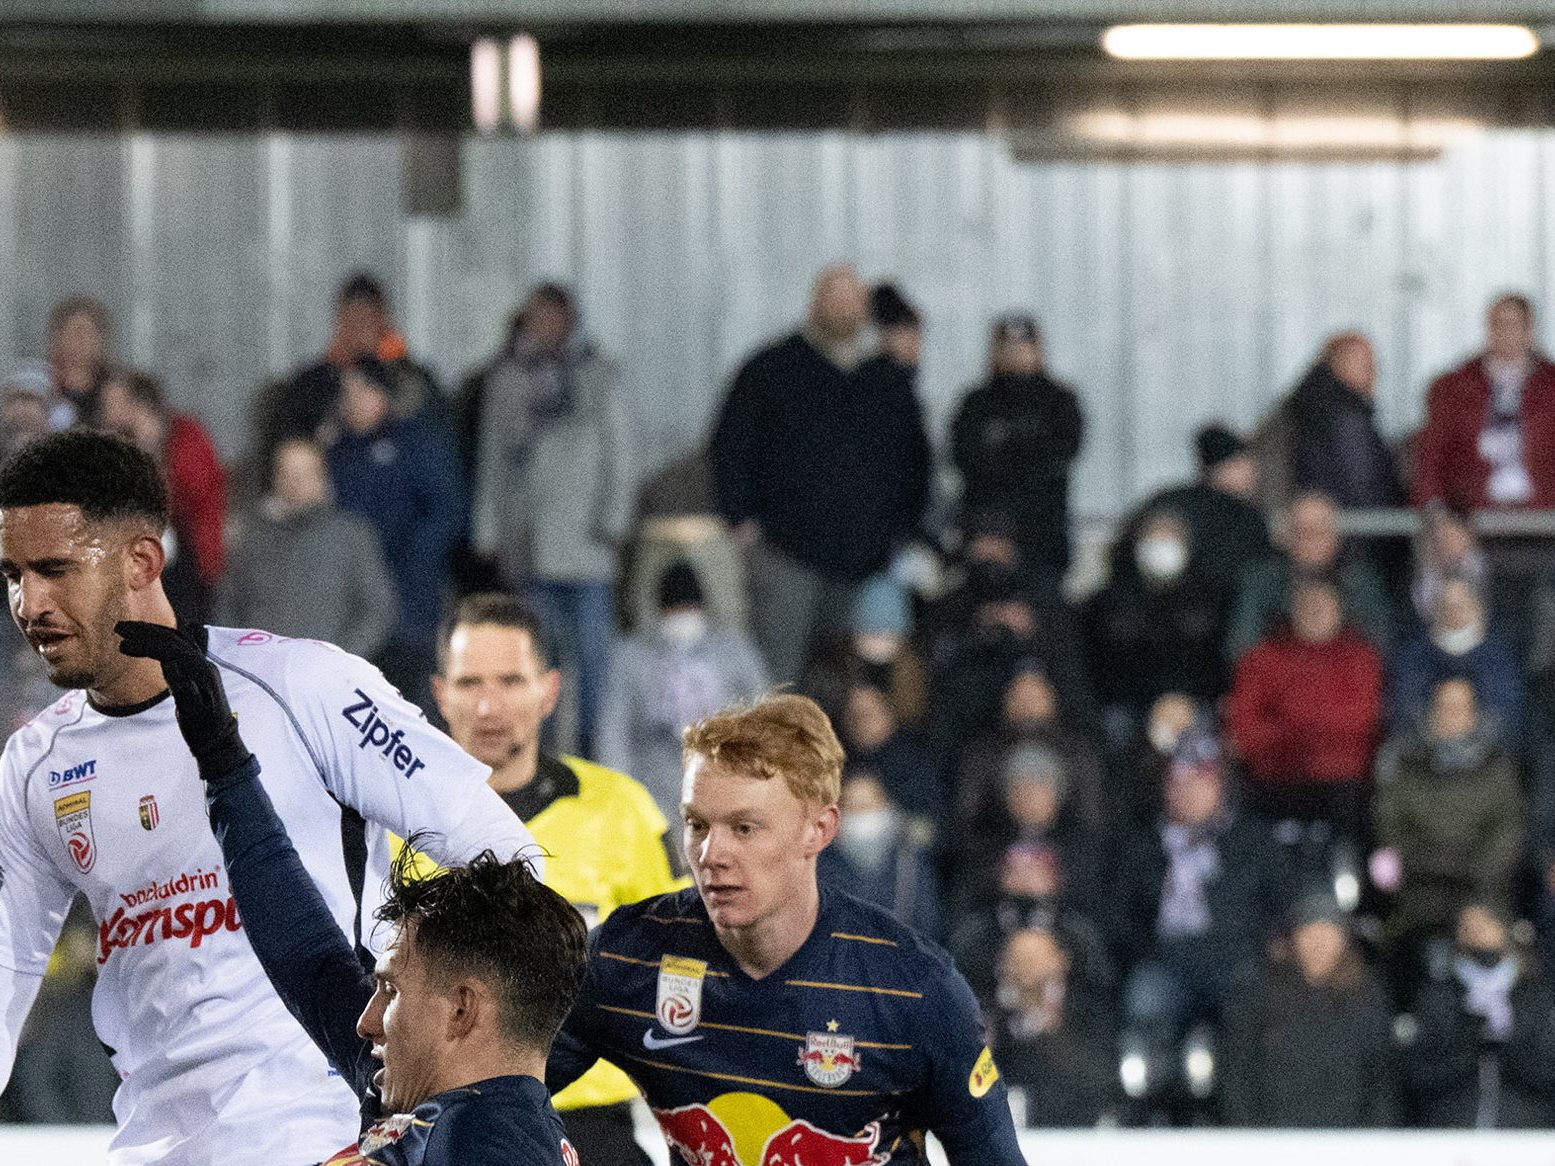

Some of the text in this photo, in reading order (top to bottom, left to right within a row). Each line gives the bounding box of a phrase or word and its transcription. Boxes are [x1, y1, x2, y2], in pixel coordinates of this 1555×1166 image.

[342, 688, 426, 779] Zipfer
[63, 760, 97, 782] BWT
[58, 810, 89, 828] BUNDES
[66, 821, 83, 833] LIGA
